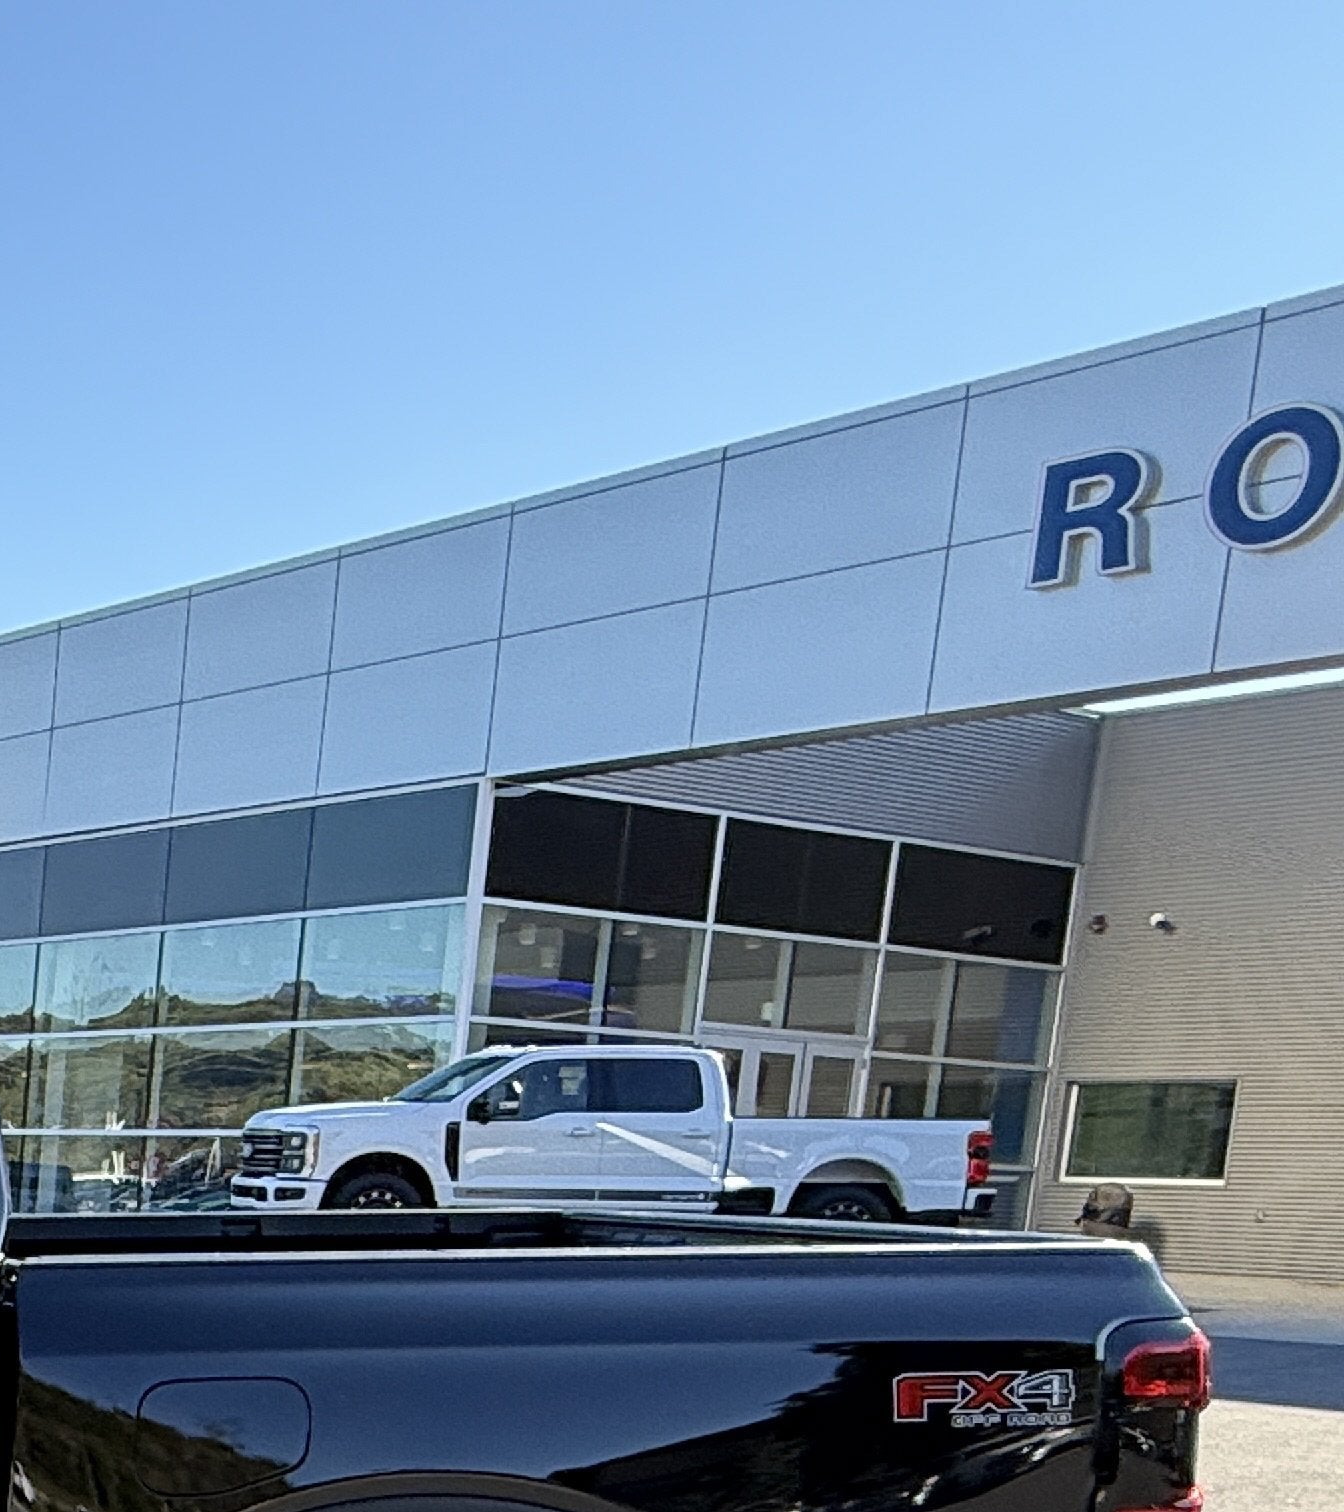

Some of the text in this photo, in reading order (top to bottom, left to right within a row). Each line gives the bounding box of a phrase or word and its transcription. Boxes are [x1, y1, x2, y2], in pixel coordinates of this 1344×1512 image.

[893, 1369, 1075, 1422] FX4
[950, 1412, 1072, 1428] OFF ROAD
